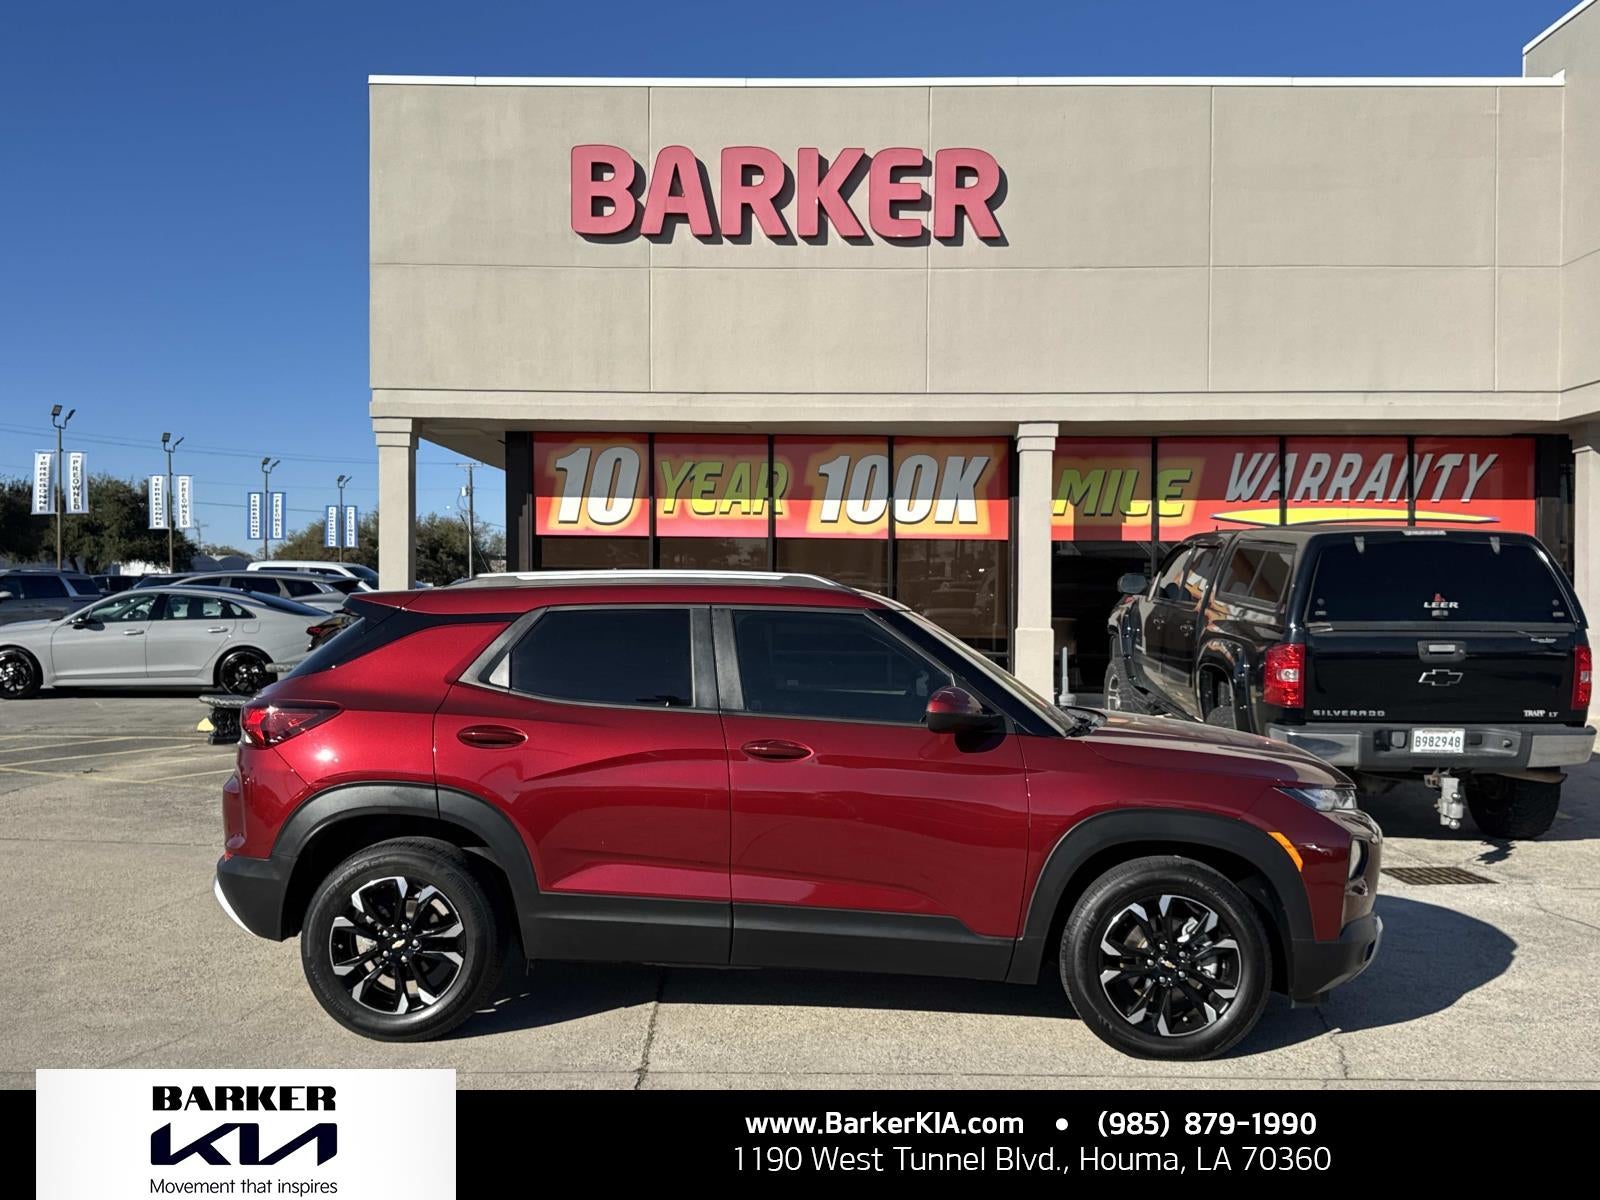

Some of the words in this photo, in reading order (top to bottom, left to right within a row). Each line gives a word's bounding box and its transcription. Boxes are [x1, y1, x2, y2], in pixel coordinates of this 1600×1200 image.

[570, 144, 1005, 243] BARKER
[72, 460, 81, 510] PREOWNED
[554, 446, 641, 526] 10
[659, 459, 790, 516] YEAR
[818, 455, 990, 525] 100K
[1052, 468, 1192, 518] MILE
[1225, 452, 1499, 504] WARRANTY
[1423, 601, 1459, 609] LEER
[1312, 709, 1386, 717] SILVERADO
[1415, 736, 1461, 748] B982948
